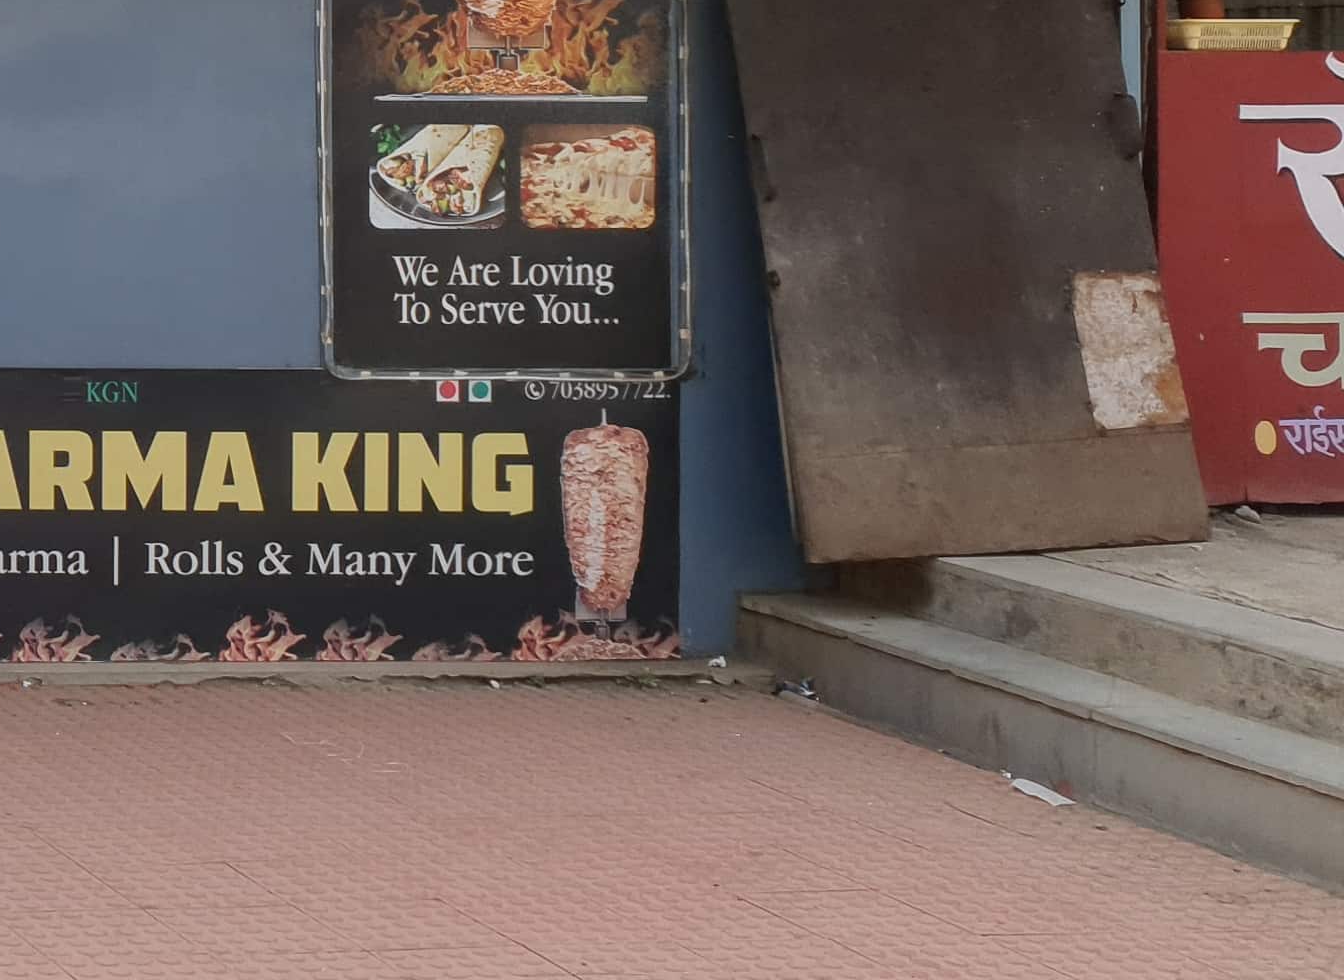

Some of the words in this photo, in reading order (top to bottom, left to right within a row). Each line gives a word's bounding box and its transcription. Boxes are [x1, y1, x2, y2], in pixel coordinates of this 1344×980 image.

[392, 255, 439, 287] We
[447, 255, 501, 287] Are
[510, 255, 615, 295] Loving
[393, 293, 431, 325] To
[441, 292, 525, 325] Serve
[532, 294, 619, 325] You...
[87, 381, 138, 403] KGN
[291, 431, 534, 516] KING
[144, 540, 244, 576] Rolls
[258, 542, 292, 576] &
[305, 543, 417, 586] Many
[428, 544, 534, 576] More
